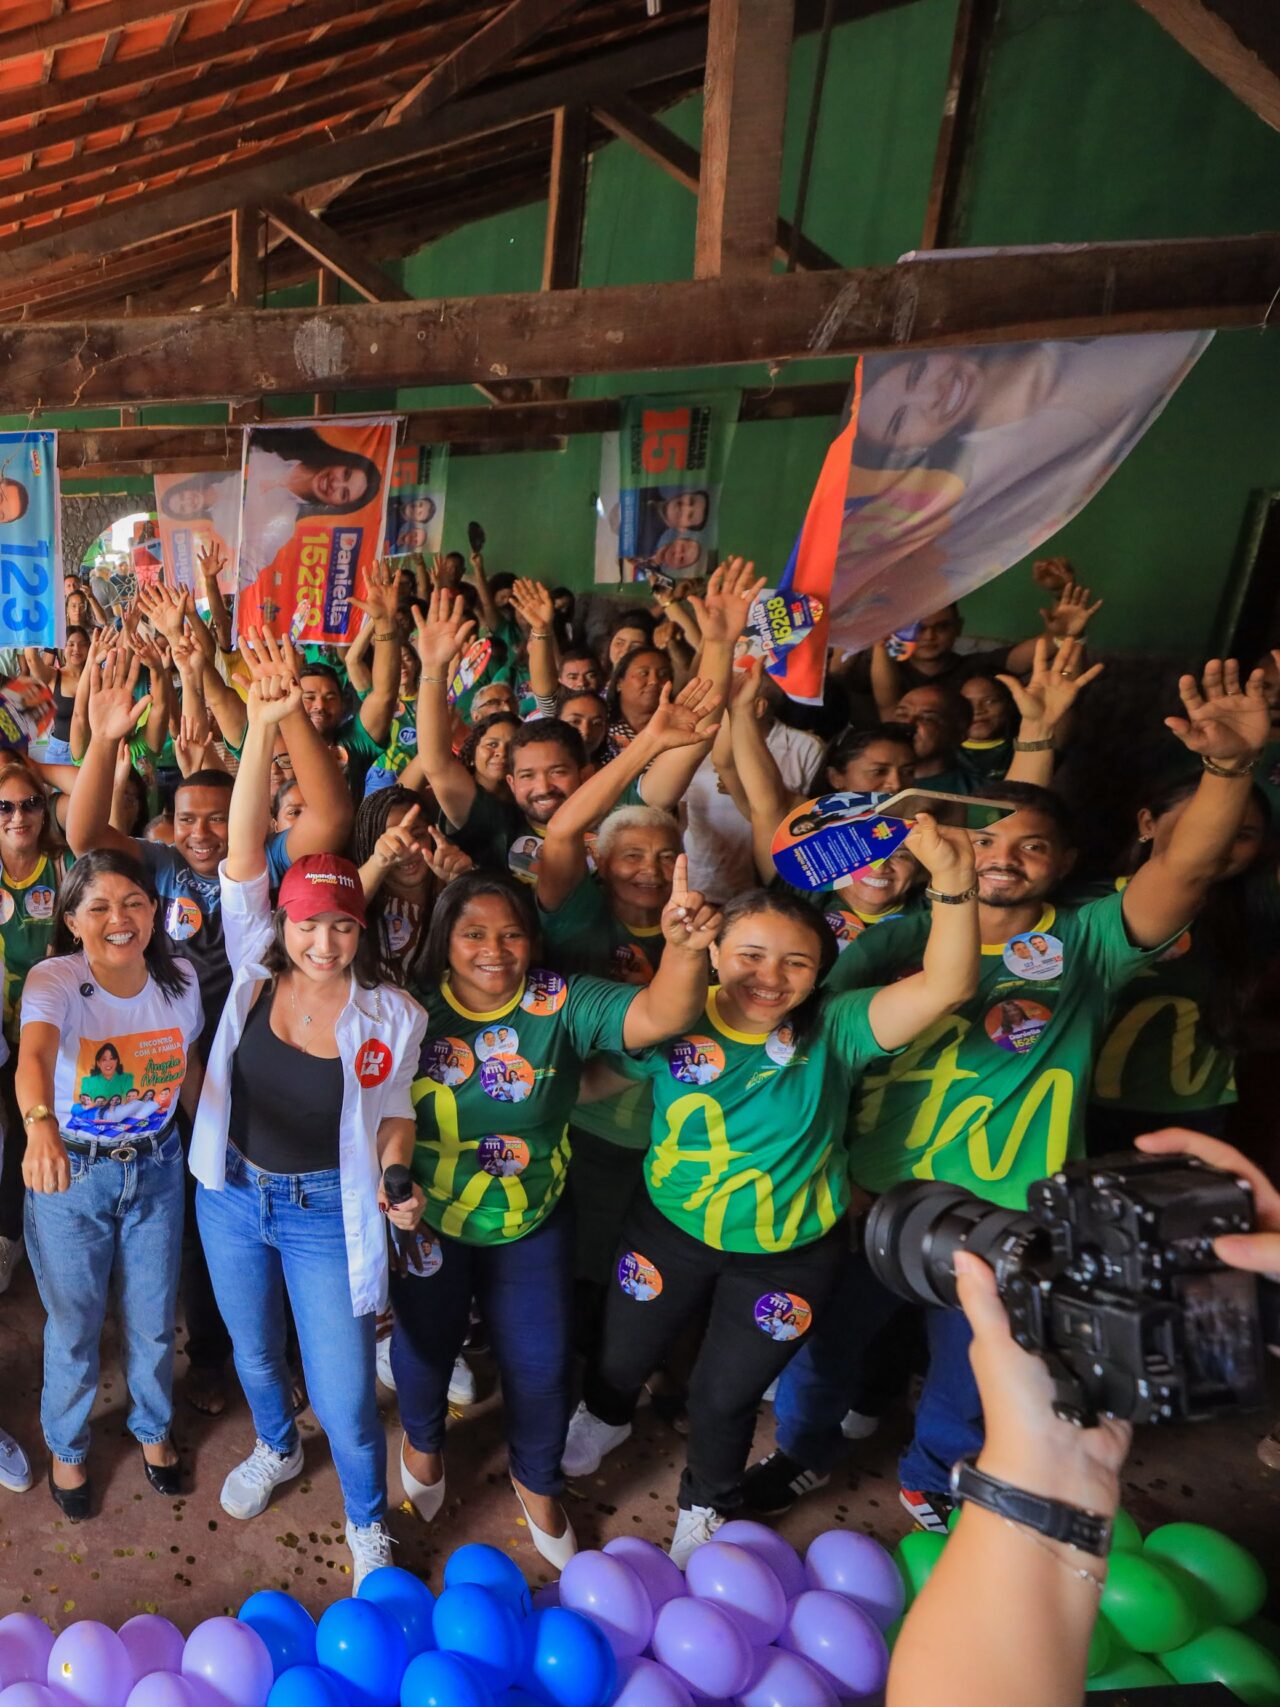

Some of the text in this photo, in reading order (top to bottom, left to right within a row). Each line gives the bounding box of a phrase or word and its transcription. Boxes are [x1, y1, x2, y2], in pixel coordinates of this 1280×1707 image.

[641, 406, 690, 474] 15
[0, 539, 49, 633] 123
[329, 532, 358, 626] Daniella
[753, 603, 775, 652] Daniella
[767, 596, 795, 645] 15258
[304, 872, 355, 889] Amanda 1111
[139, 1036, 173, 1048] ENCONTRO
[433, 1045, 449, 1054] 1111
[1012, 1035, 1040, 1048] 1525
[134, 1049, 151, 1057] COM
[674, 1047, 692, 1056] 1111
[770, 1296, 788, 1311] 1111
